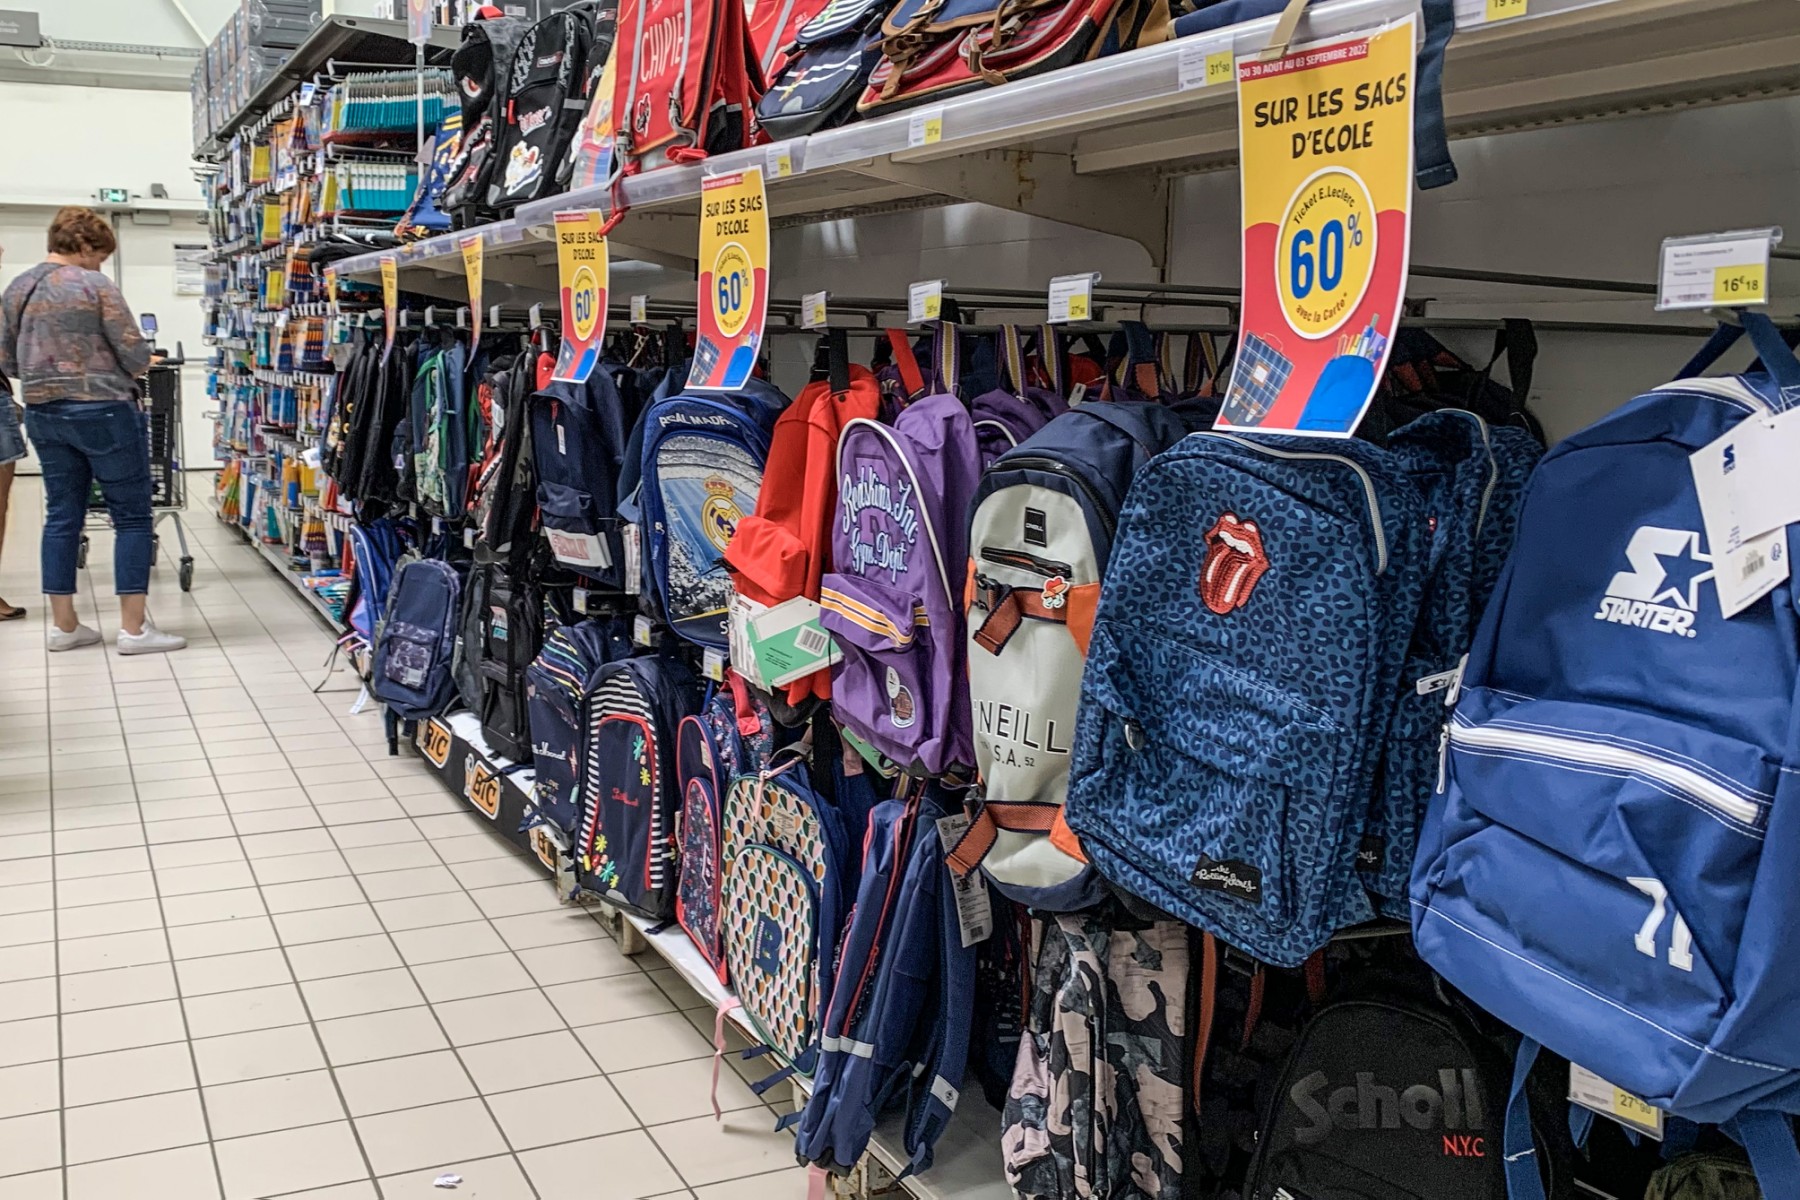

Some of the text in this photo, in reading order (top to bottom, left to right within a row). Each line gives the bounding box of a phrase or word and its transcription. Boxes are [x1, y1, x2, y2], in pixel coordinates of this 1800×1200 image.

[641, 12, 683, 83] CHIPIE
[1239, 68, 1251, 78] DU
[1252, 65, 1262, 76] 30
[1284, 59, 1295, 70] AU
[1295, 57, 1305, 68] 03
[1306, 48, 1348, 66] SEPTEMBRE
[1348, 43, 1367, 57] 2022
[1254, 72, 1407, 128] SUR LES SACS
[1292, 120, 1374, 159] D'ECOLE
[705, 194, 763, 218] SUR LES SACS
[1293, 193, 1317, 225] Ticket
[561, 232, 575, 244] SUR
[716, 218, 750, 237] D'ECOLE
[1722, 275, 1759, 293] 16€18
[1296, 304, 1312, 322] avec
[1312, 310, 1321, 323] la
[658, 412, 692, 428] REAL
[1024, 756, 1036, 767] 52
[473, 771, 498, 807] BIC
